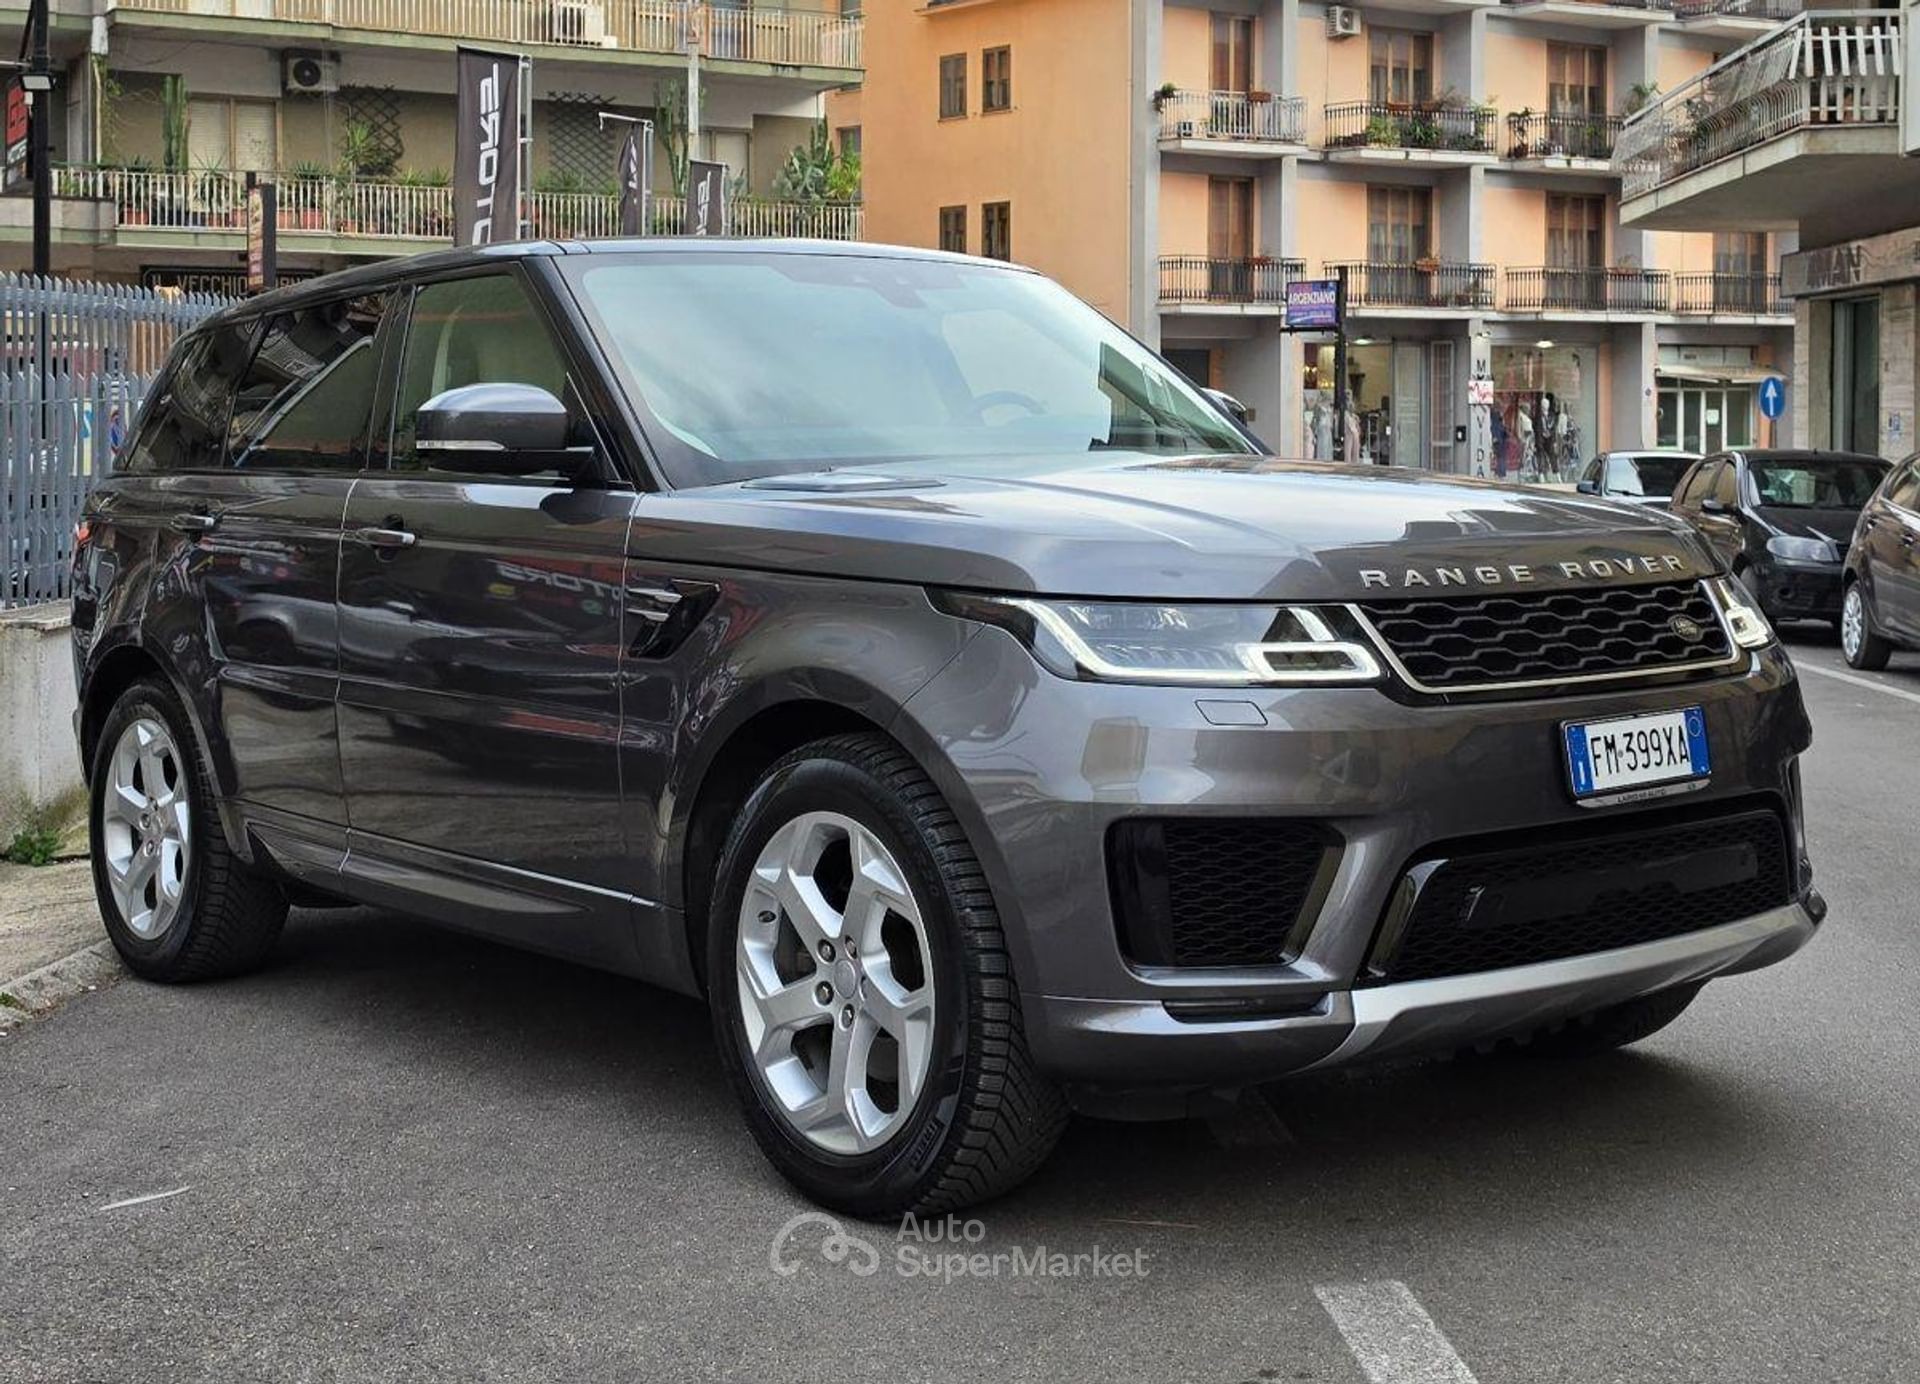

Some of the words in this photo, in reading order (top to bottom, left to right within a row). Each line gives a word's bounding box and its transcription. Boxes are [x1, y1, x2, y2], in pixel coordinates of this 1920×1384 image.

[177, 275, 248, 297] VECCHIO
[1288, 290, 1336, 305] ARGENZIANO
[1360, 564, 1536, 588] RANGE
[1560, 555, 1685, 580] ROVER
